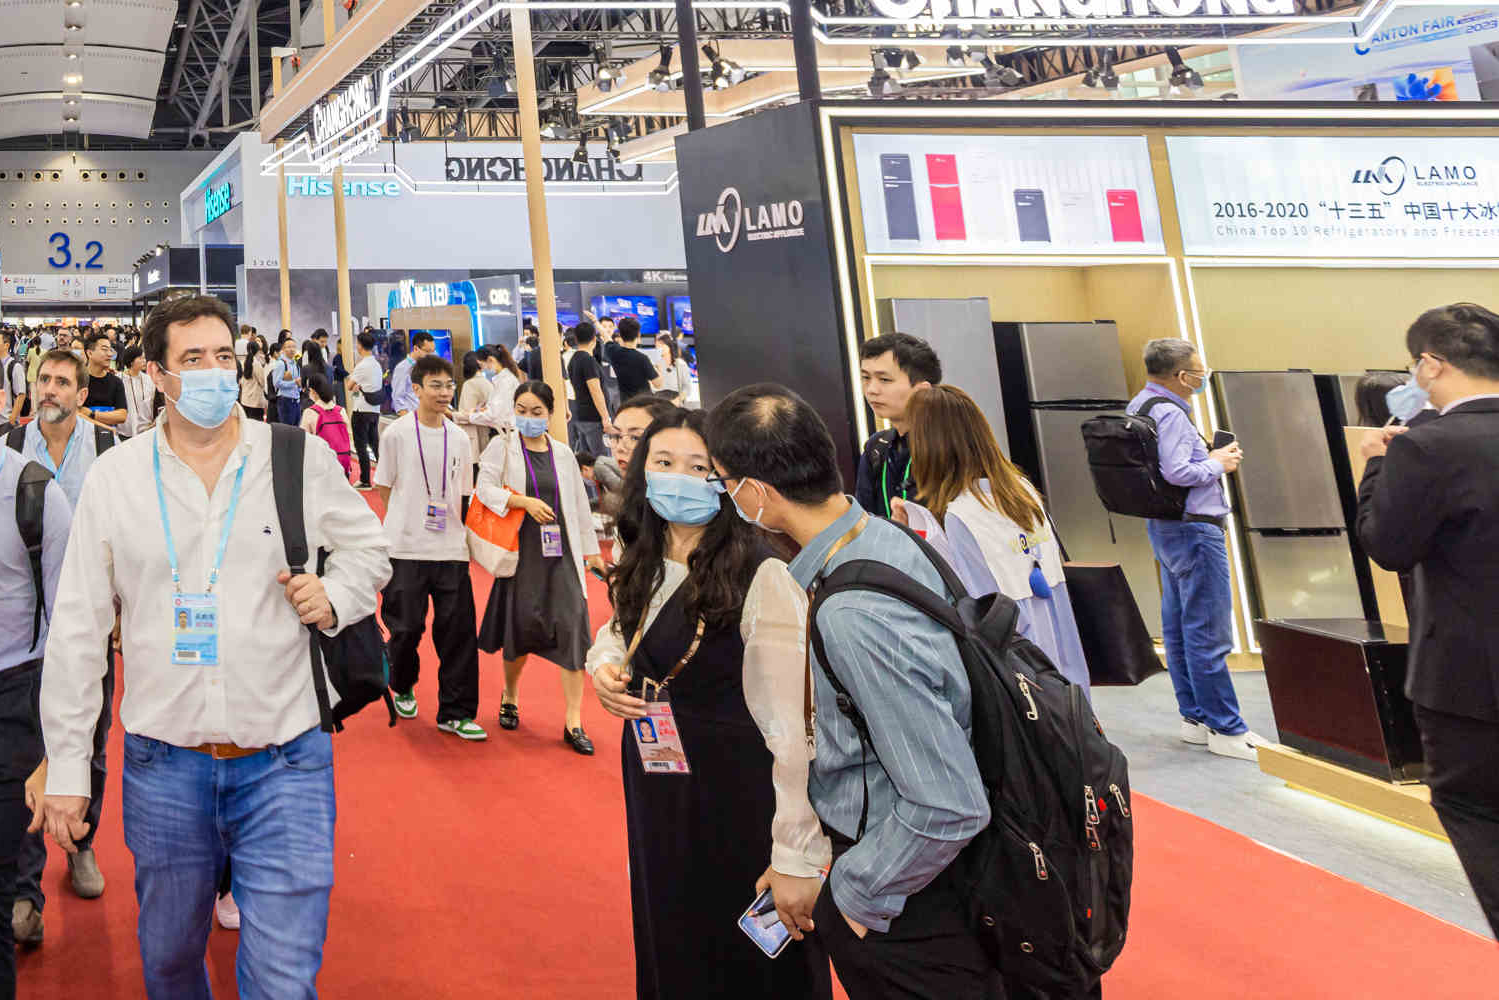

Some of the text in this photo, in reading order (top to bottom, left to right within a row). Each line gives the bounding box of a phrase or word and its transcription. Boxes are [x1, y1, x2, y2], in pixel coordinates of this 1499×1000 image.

[1422, 15, 1456, 34] FAIR
[1413, 165, 1478, 181] LAMO
[287, 175, 400, 197] Hisense
[744, 199, 804, 231] LAMO
[1213, 201, 1309, 219] 2016-2020
[1403, 200, 1499, 221] 中国十大冰
[1216, 224, 1256, 237] China
[1260, 224, 1287, 239] Top
[1292, 224, 1309, 237] 10
[47, 231, 104, 270] 3.2
